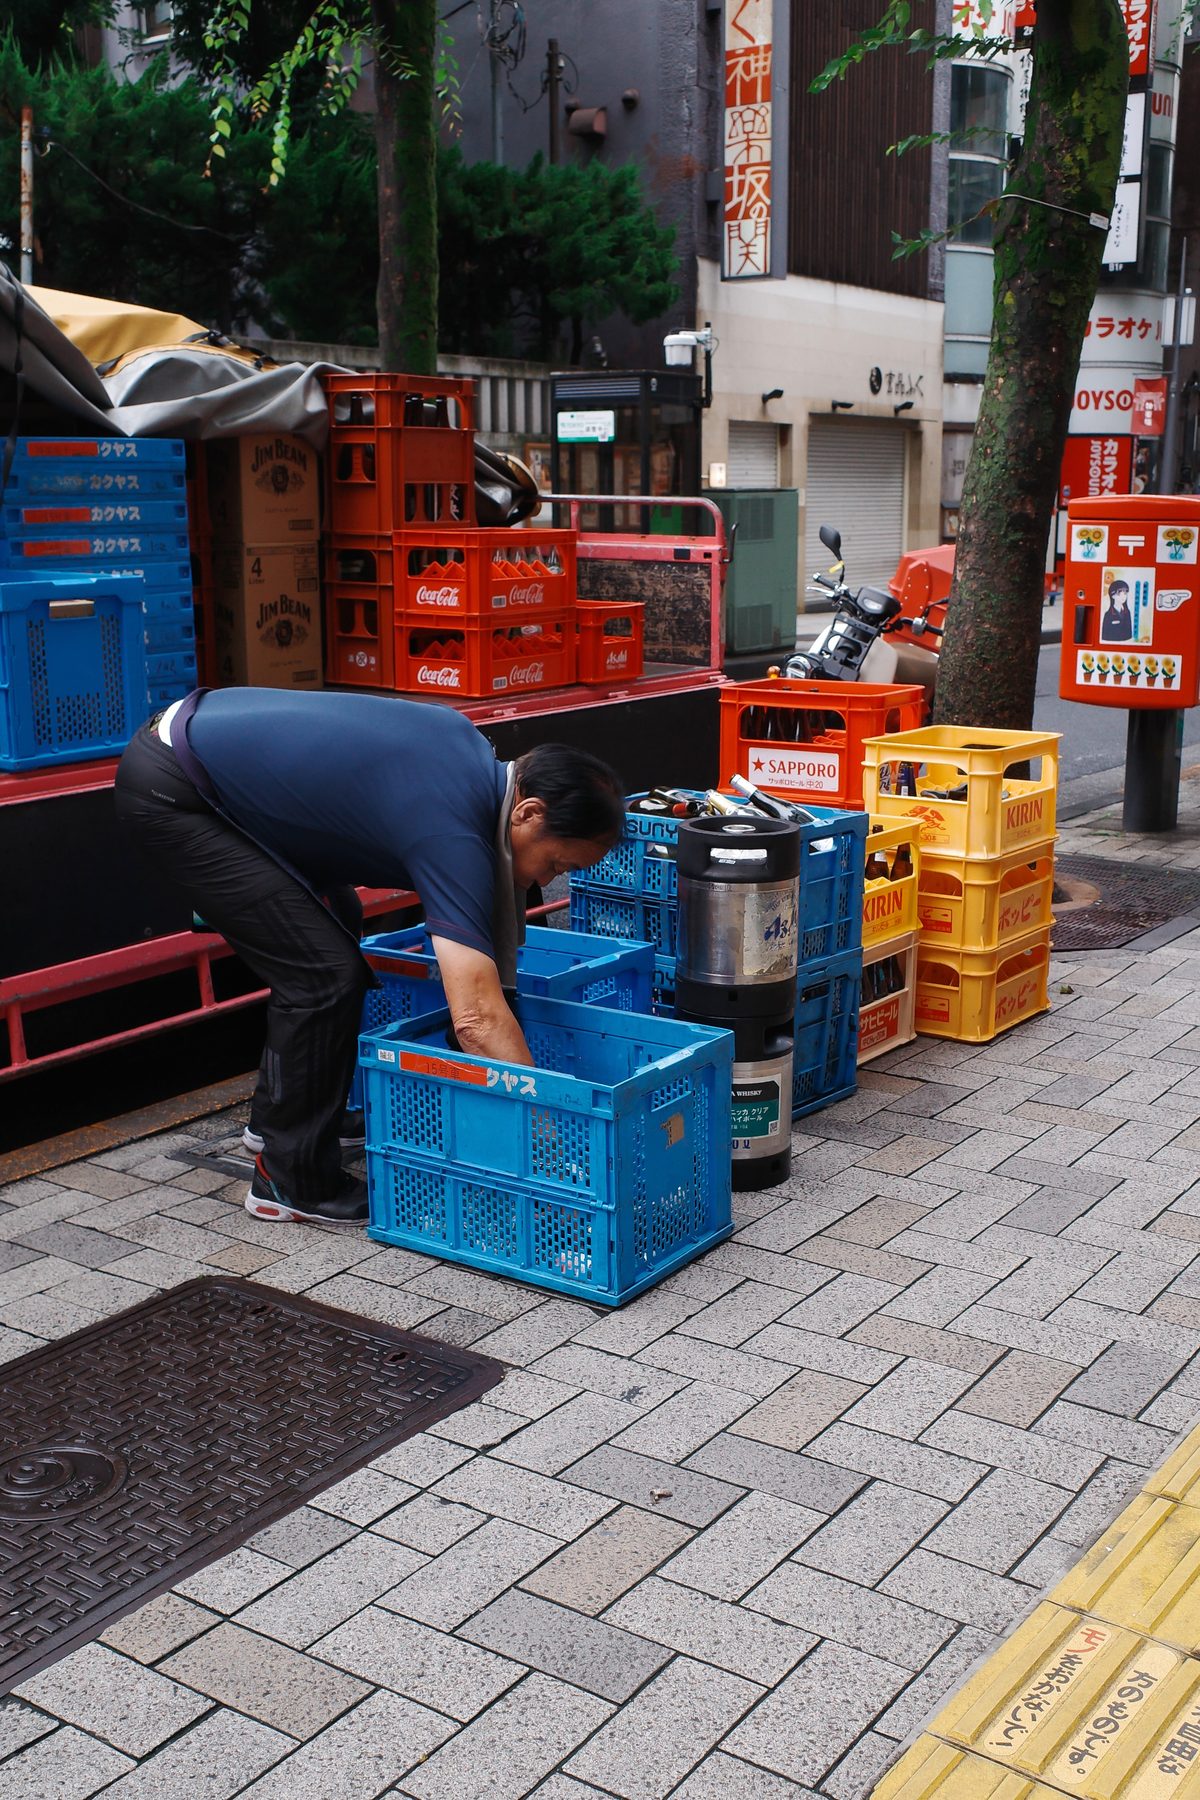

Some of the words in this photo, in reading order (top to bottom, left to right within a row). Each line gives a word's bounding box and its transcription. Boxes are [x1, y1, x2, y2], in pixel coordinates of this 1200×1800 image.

[97, 442, 138, 458] クヤス
[251, 441, 273, 472] JIM
[275, 438, 308, 472] BEAM
[90, 474, 140, 490] カクヤス
[91, 506, 141, 521] カクヤス
[93, 538, 142, 554] カクヤス
[251, 557, 262, 578] 4
[416, 585, 460, 607] Coca-Cola
[509, 583, 544, 606] Coca-Cola
[255, 601, 278, 630] JIM
[279, 594, 311, 625] BEAM
[417, 664, 461, 688] Coca-Cola
[510, 662, 544, 685] Coca-Cola
[768, 759, 837, 778] SAPPORO
[768, 777, 805, 787] サッポロビール
[1006, 797, 1043, 830] KIRIN
[863, 887, 903, 922] KIRIN
[998, 894, 1041, 931] ホッピー
[994, 980, 1038, 1022] ホッピー
[426, 1062, 460, 1080] 15号車
[1068, 1669, 1158, 1776] 方のものです。
